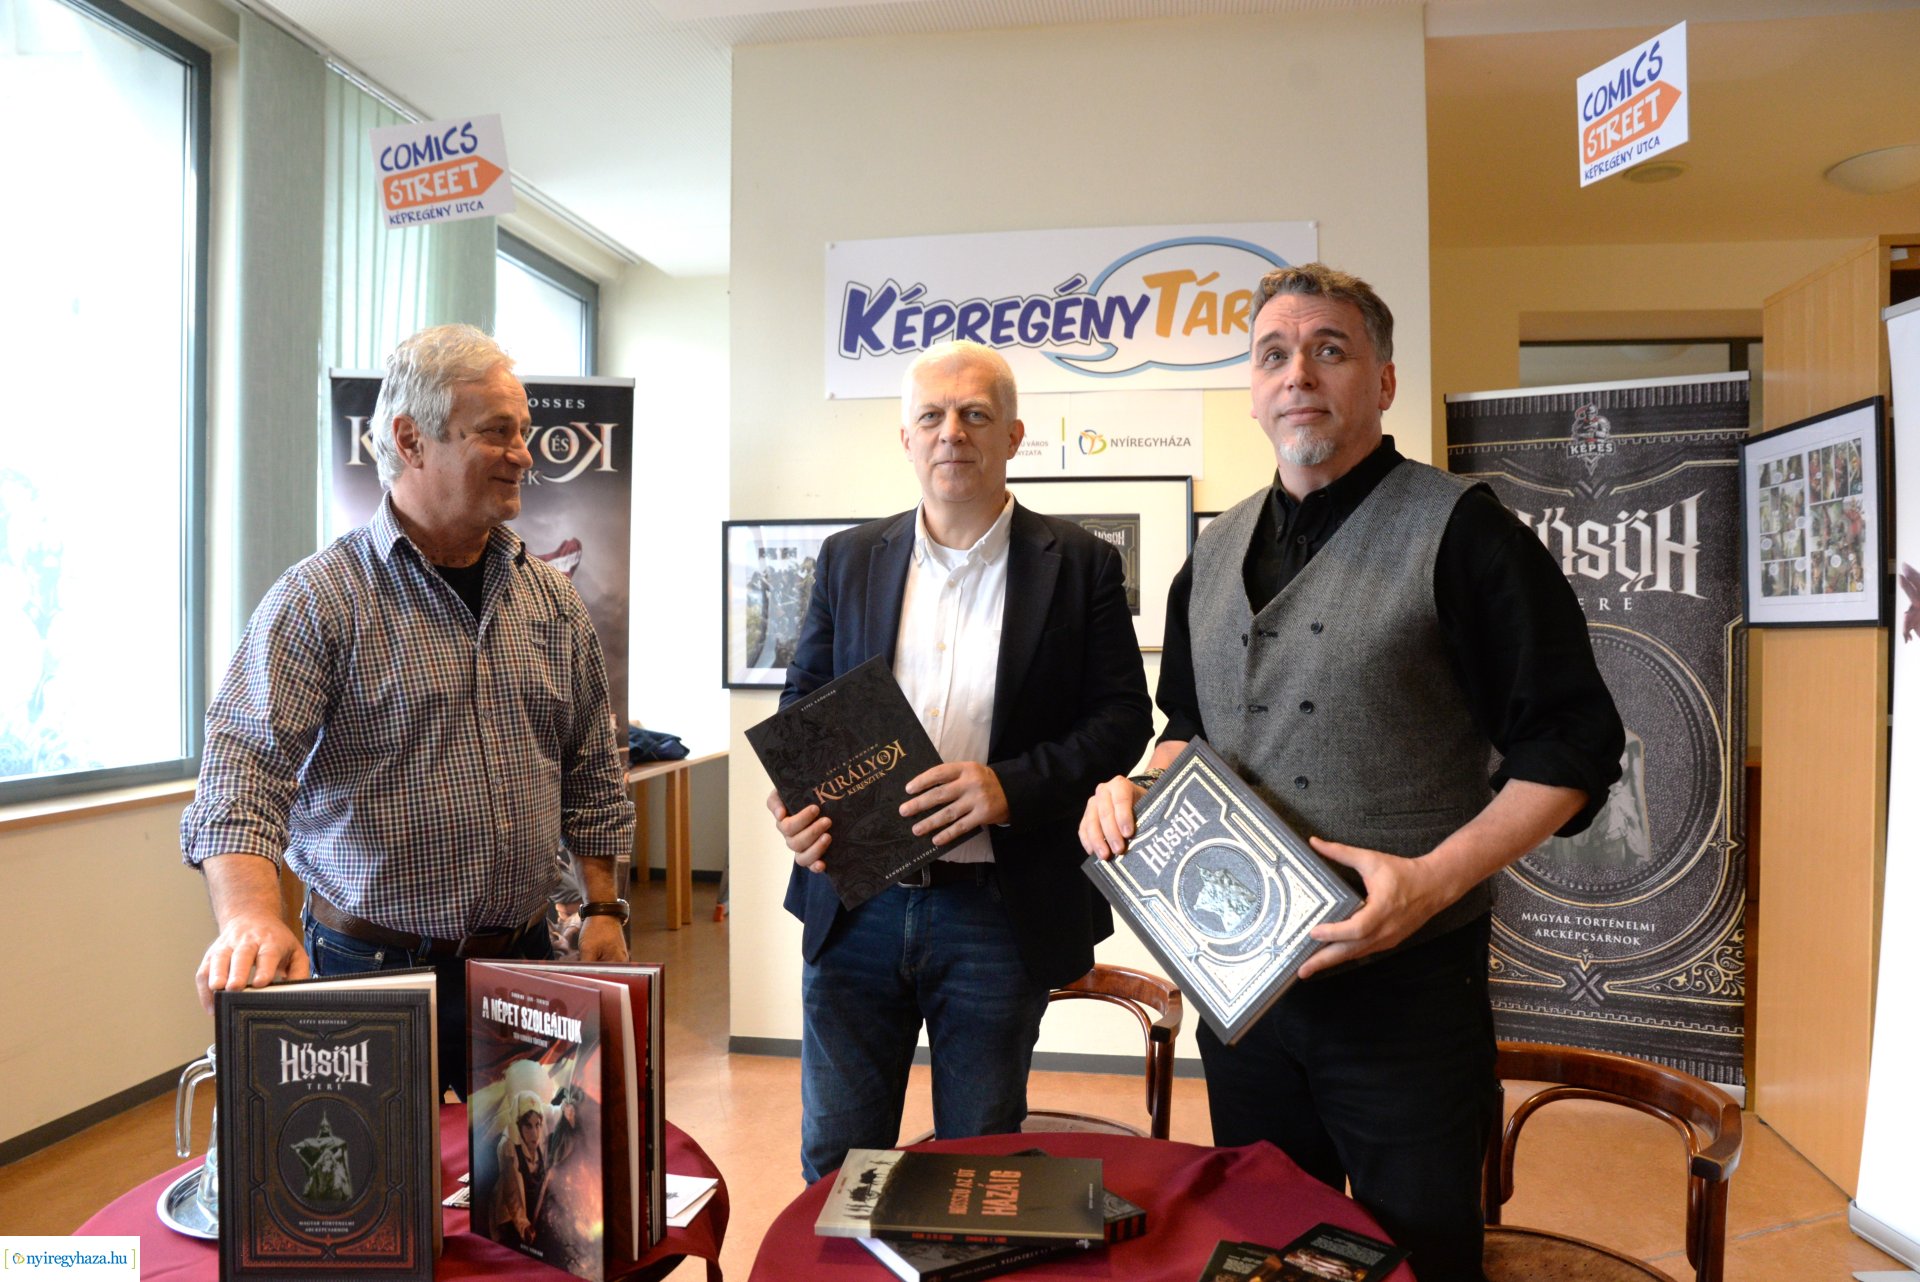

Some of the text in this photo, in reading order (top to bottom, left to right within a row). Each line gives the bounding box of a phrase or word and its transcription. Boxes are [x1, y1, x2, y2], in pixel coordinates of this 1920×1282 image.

[1583, 40, 1663, 122] COMICS
[1586, 88, 1661, 158] STREET
[380, 121, 478, 172] COMICS
[1584, 135, 1660, 181] KÉPREGÉNY UTCA
[389, 162, 479, 206] STREET
[389, 200, 484, 225] KÉPREGÉNY UTCA
[551, 435, 569, 452] ÉS
[1027, 439, 1049, 448] VÁROS
[1110, 435, 1191, 448] NYÍREGYHÁZA
[812, 739, 907, 805] KIRÁLYOK
[1521, 912, 1656, 932] MAGYAR TÖRTÉNELMI
[1535, 928, 1641, 946] ARCKÉPCSARNOK
[482, 996, 489, 1019] A
[491, 998, 519, 1028] NÉPET
[521, 1006, 582, 1044] SZOLGÁLTUK
[980, 1169, 1022, 1216] HAZÁIG
